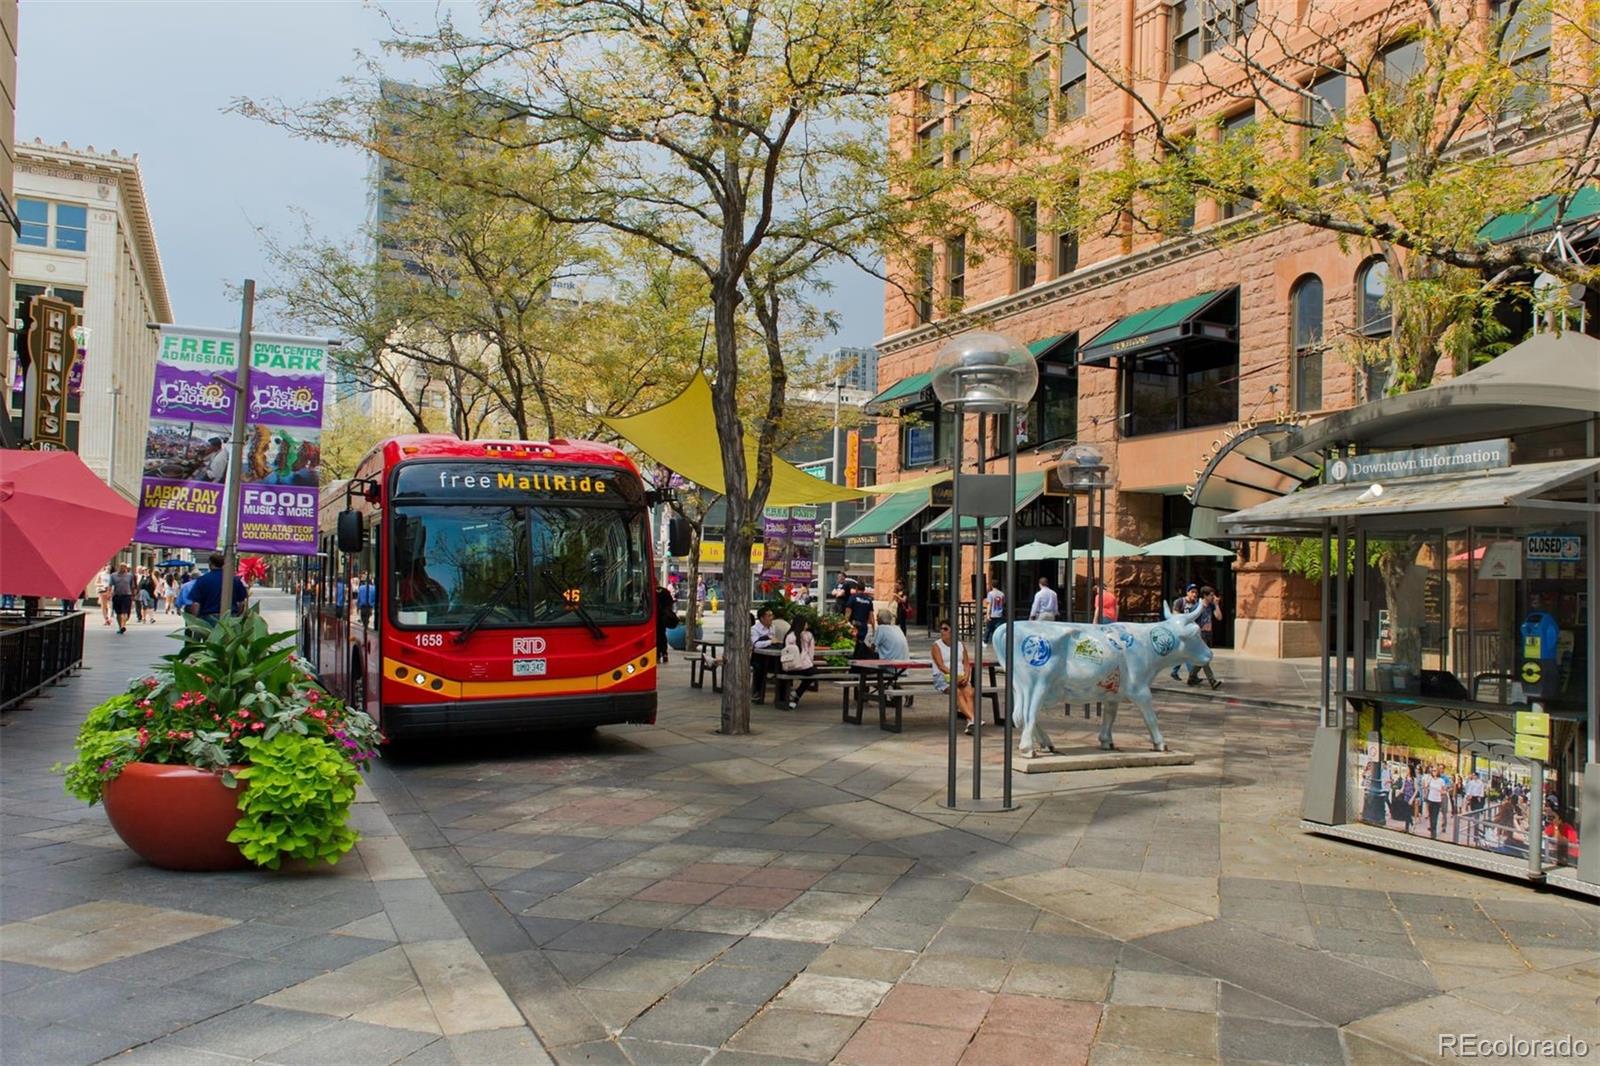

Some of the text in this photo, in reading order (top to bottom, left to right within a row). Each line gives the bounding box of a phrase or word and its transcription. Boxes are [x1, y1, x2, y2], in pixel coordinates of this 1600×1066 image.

[164, 336, 234, 356] FREE
[254, 343, 324, 357] CIVIC CENTER
[162, 351, 235, 366] ADMISSION
[254, 353, 323, 371] PARK
[1183, 415, 1258, 501] MASONIC
[1352, 450, 1500, 475] Downtown information
[439, 472, 606, 493] free MallRide
[145, 485, 220, 505] LABOR DAY
[244, 490, 314, 508] FOOD
[144, 498, 217, 514] WEEKEND
[243, 505, 314, 517] MUSIC & MORE
[242, 523, 314, 534] WWW.ATASTEOF
[242, 531, 314, 542] COLORADO.COM
[1528, 537, 1562, 553] CLOSED
[415, 634, 443, 647] 1658
[512, 636, 546, 655] RTD
